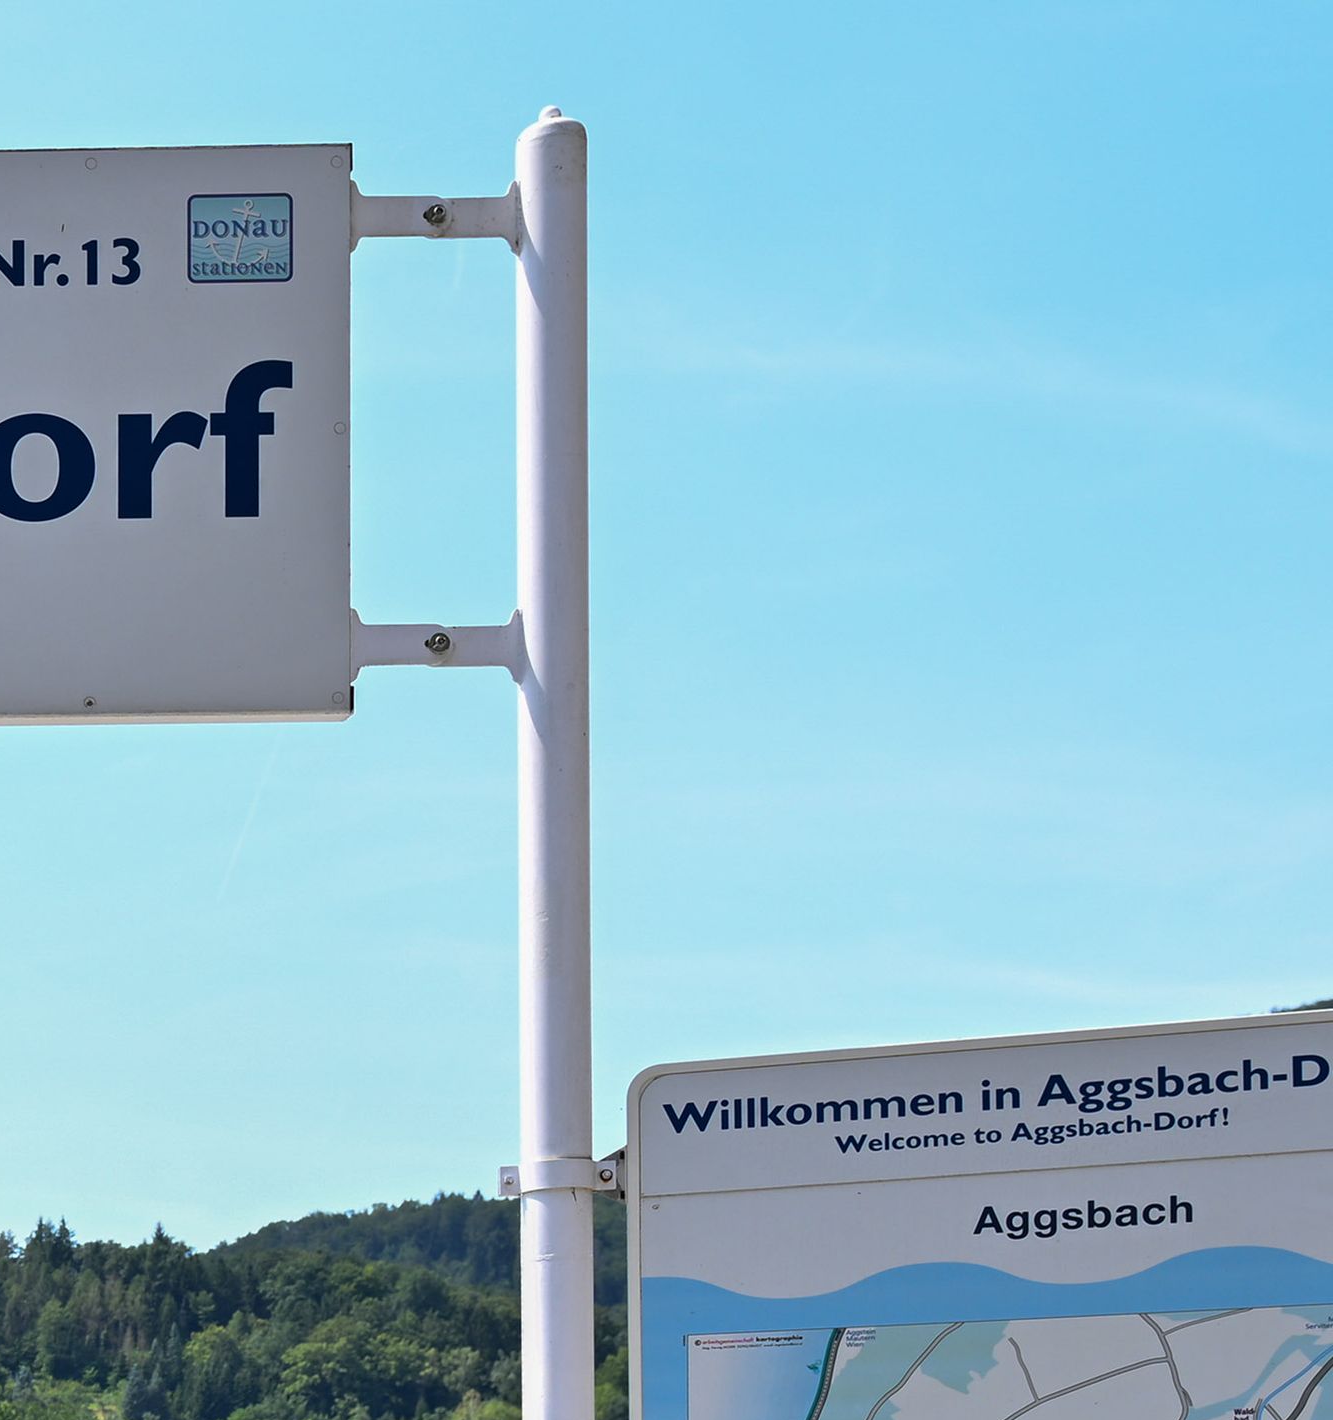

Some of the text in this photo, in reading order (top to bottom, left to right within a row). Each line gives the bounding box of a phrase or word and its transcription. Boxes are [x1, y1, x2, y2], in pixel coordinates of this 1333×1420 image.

[663, 1091, 964, 1134] Willkommen
[982, 1080, 1020, 1110] in
[835, 1106, 1232, 1153] Welcome to Aggsbach-Dorf!
[974, 1196, 1192, 1239] Aggsbach
